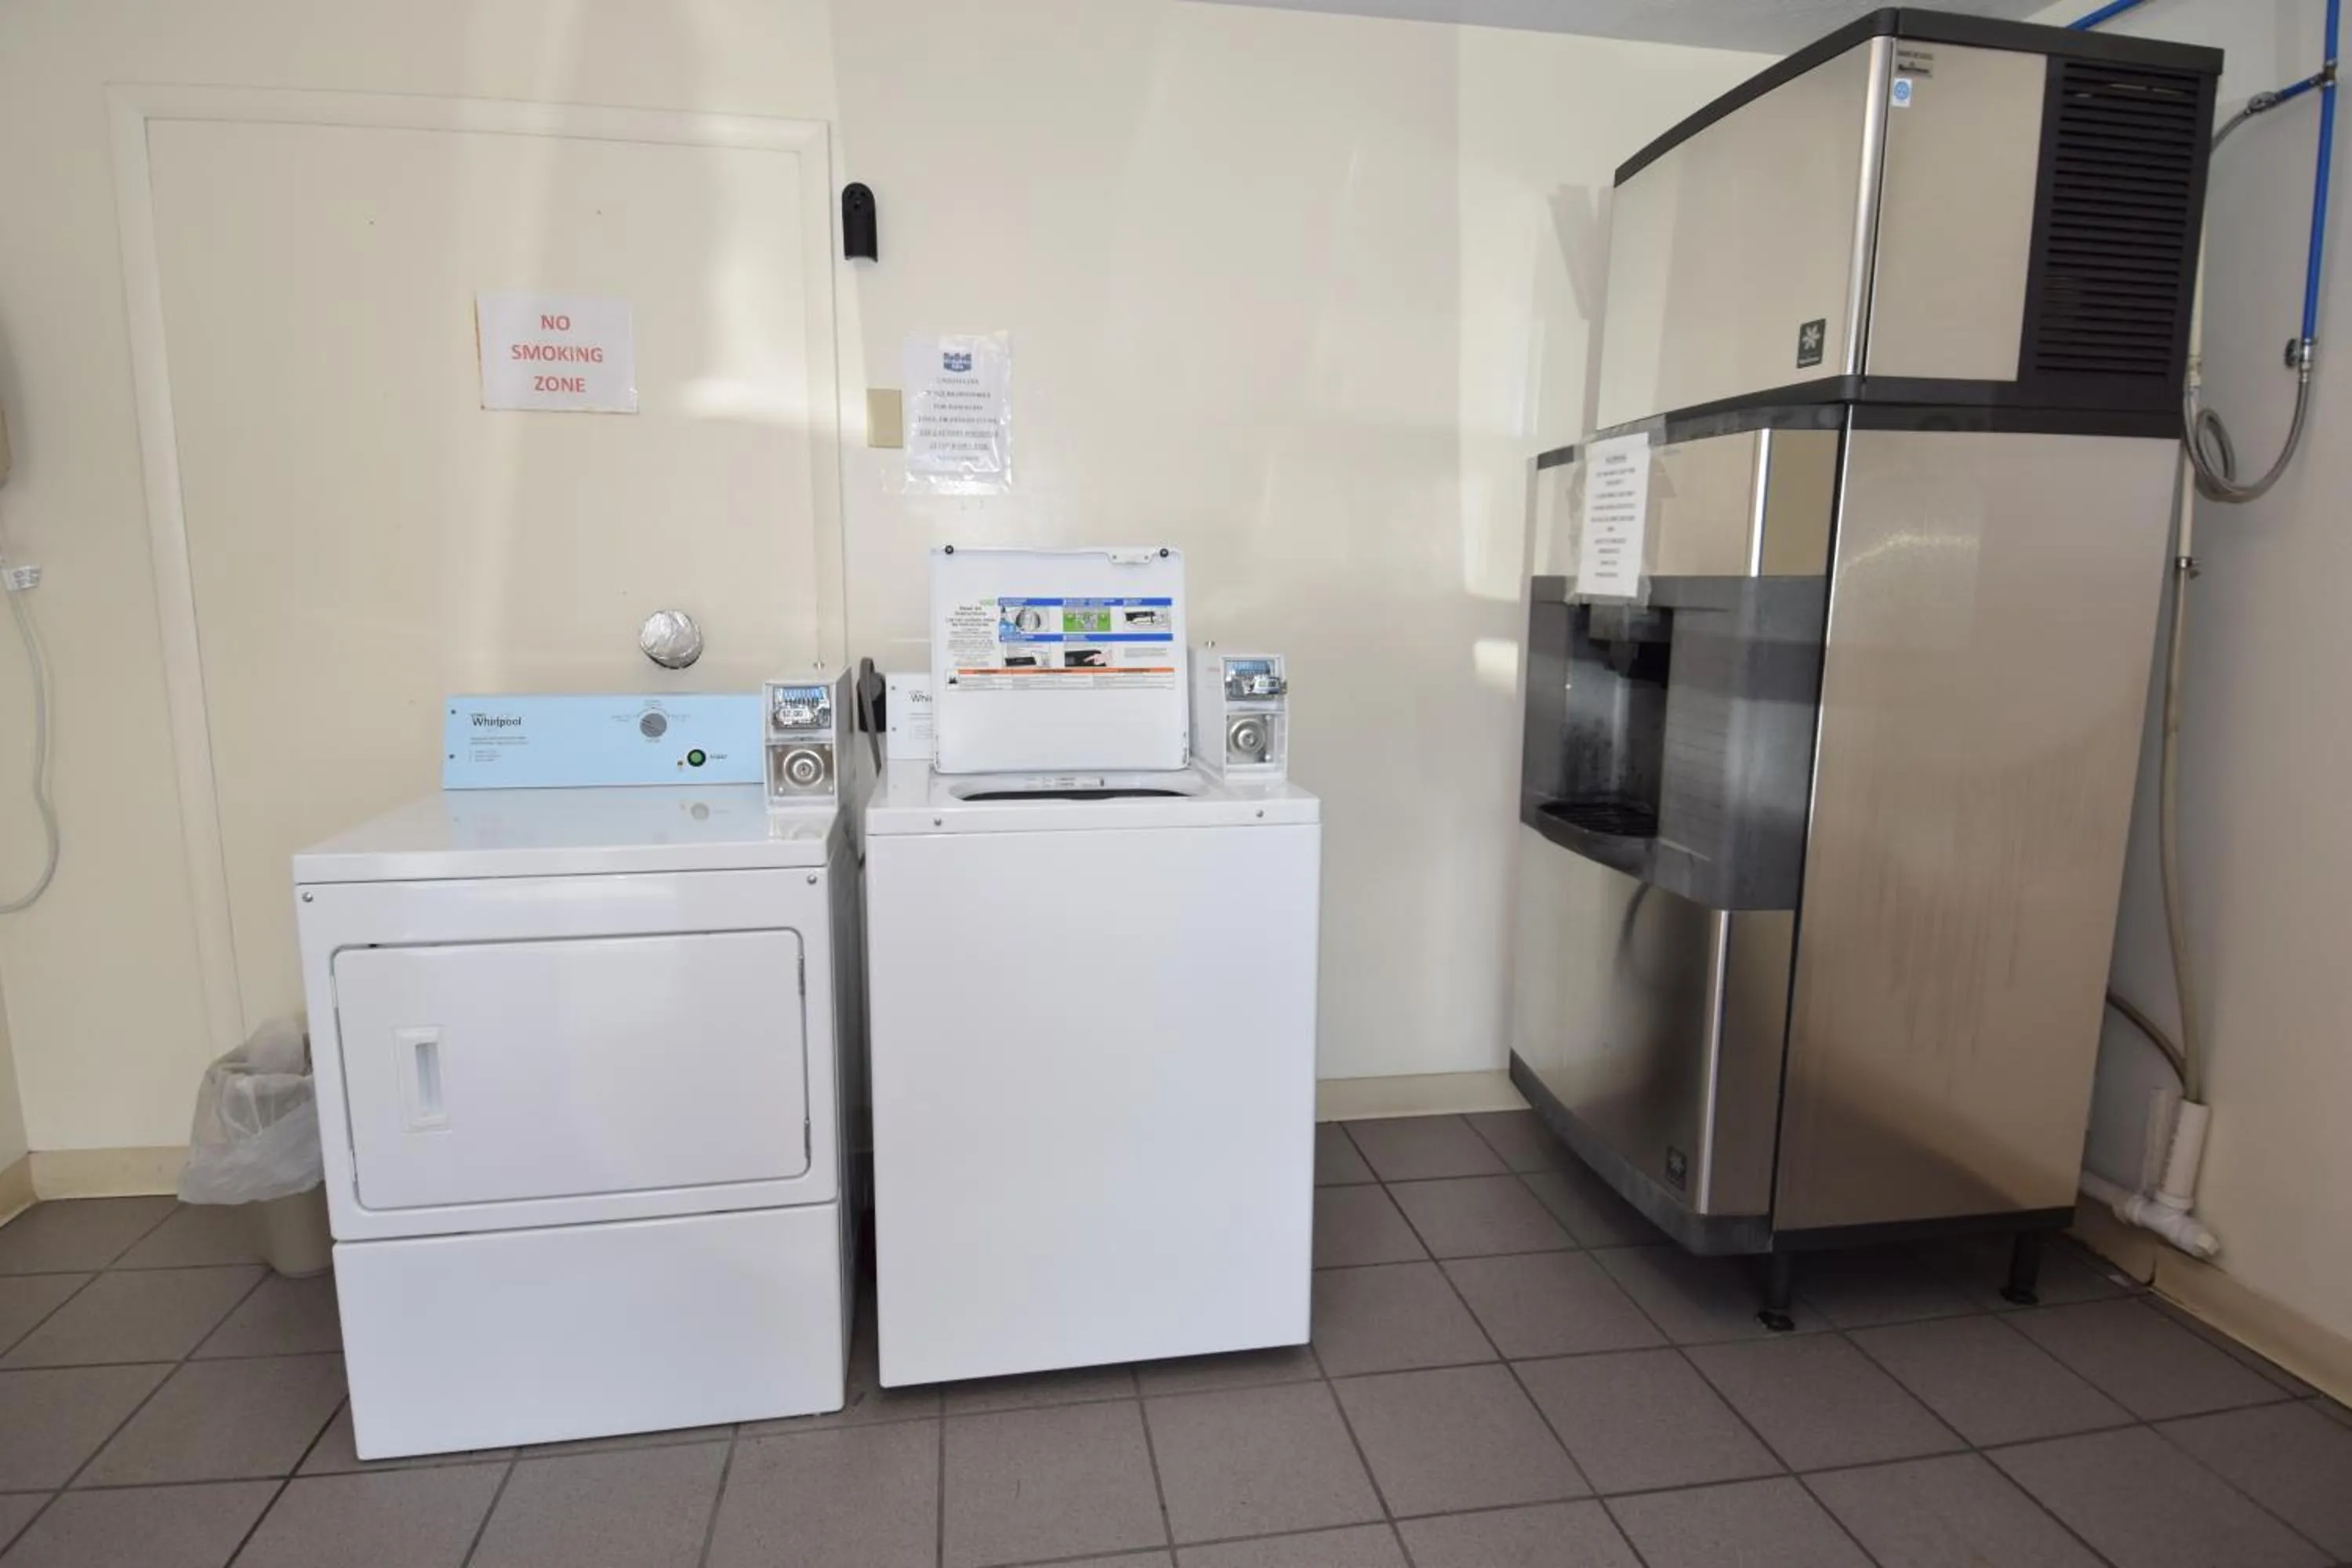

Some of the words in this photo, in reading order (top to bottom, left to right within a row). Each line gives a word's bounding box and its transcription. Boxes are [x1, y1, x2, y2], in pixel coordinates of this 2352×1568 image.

[540, 314, 571, 331] NO
[510, 344, 604, 363] SMOKING
[534, 376, 586, 393] ZONE
[471, 716, 521, 728] Whirlpool
